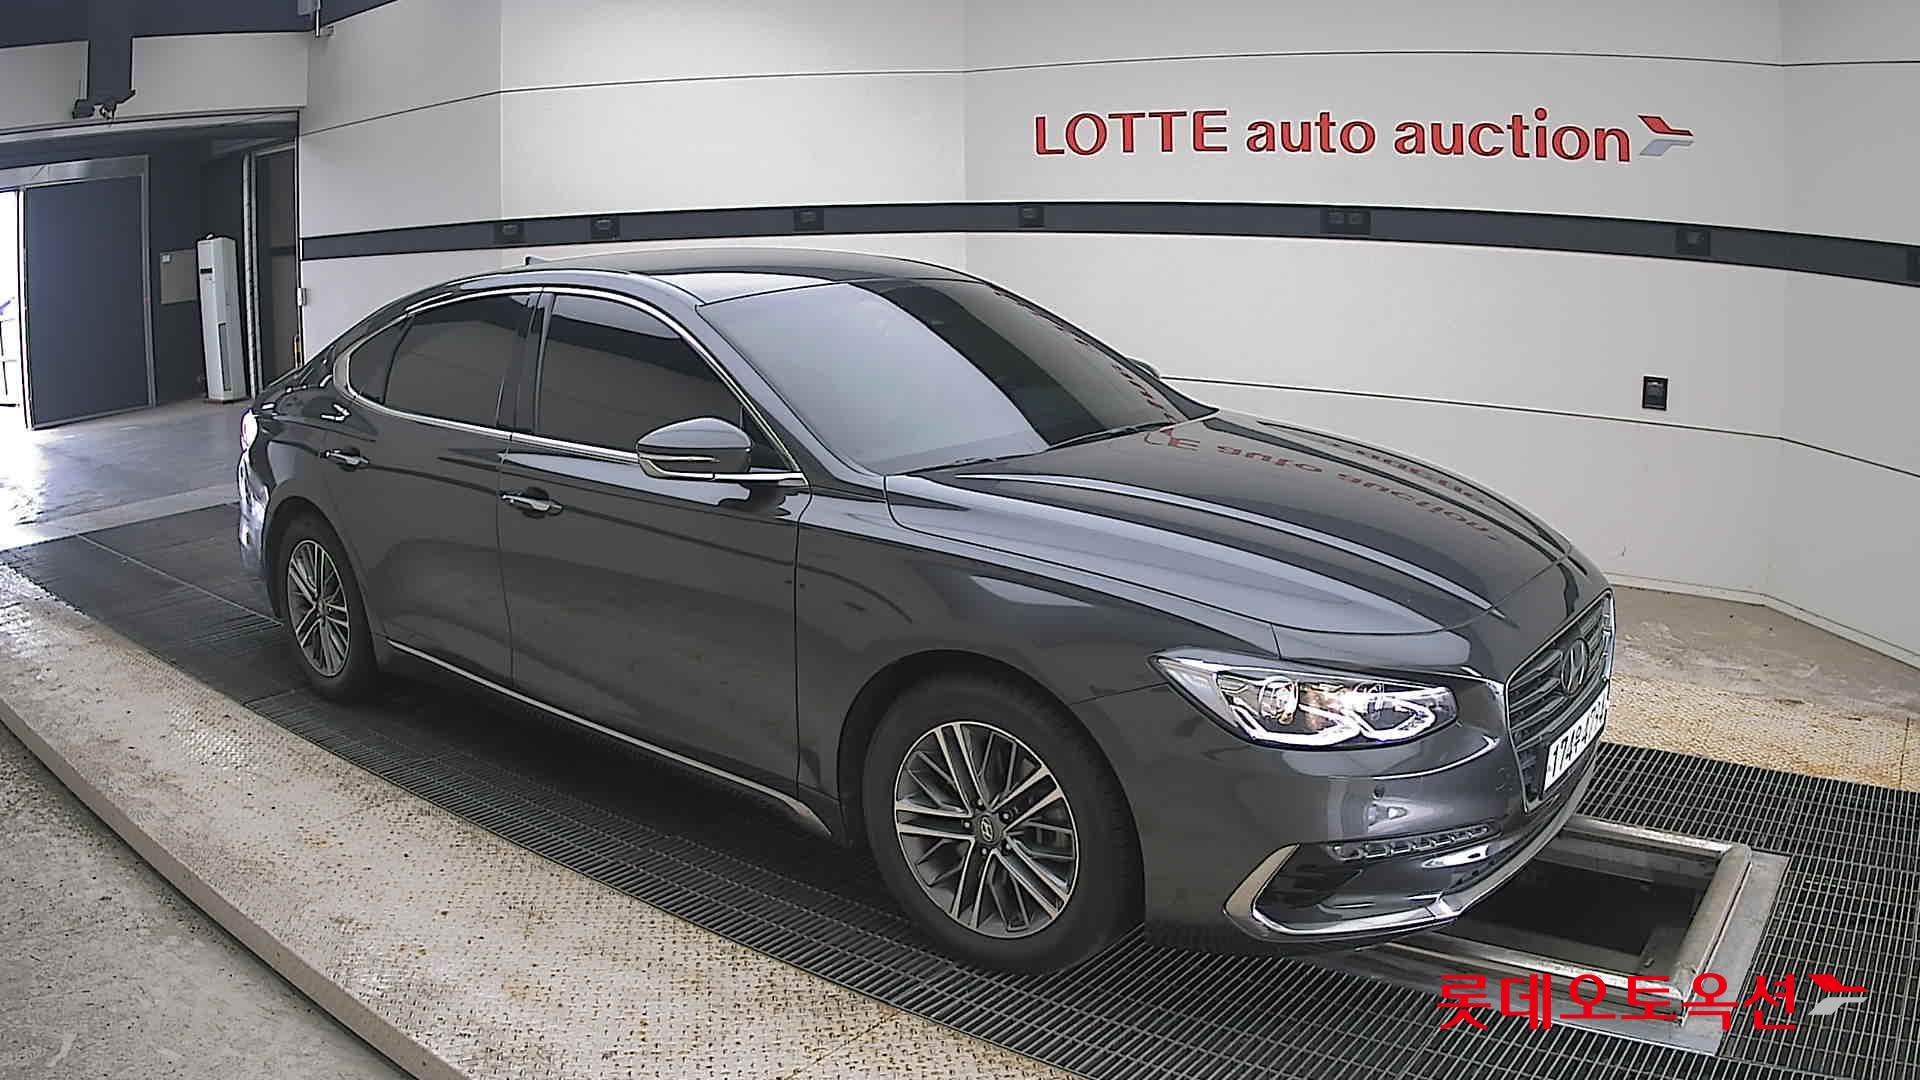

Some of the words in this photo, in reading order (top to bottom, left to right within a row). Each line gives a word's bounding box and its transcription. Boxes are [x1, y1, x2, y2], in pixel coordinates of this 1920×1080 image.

[1034, 109, 1229, 156] LOTTE
[1246, 111, 1377, 155] auto
[1394, 106, 1632, 163] auction
